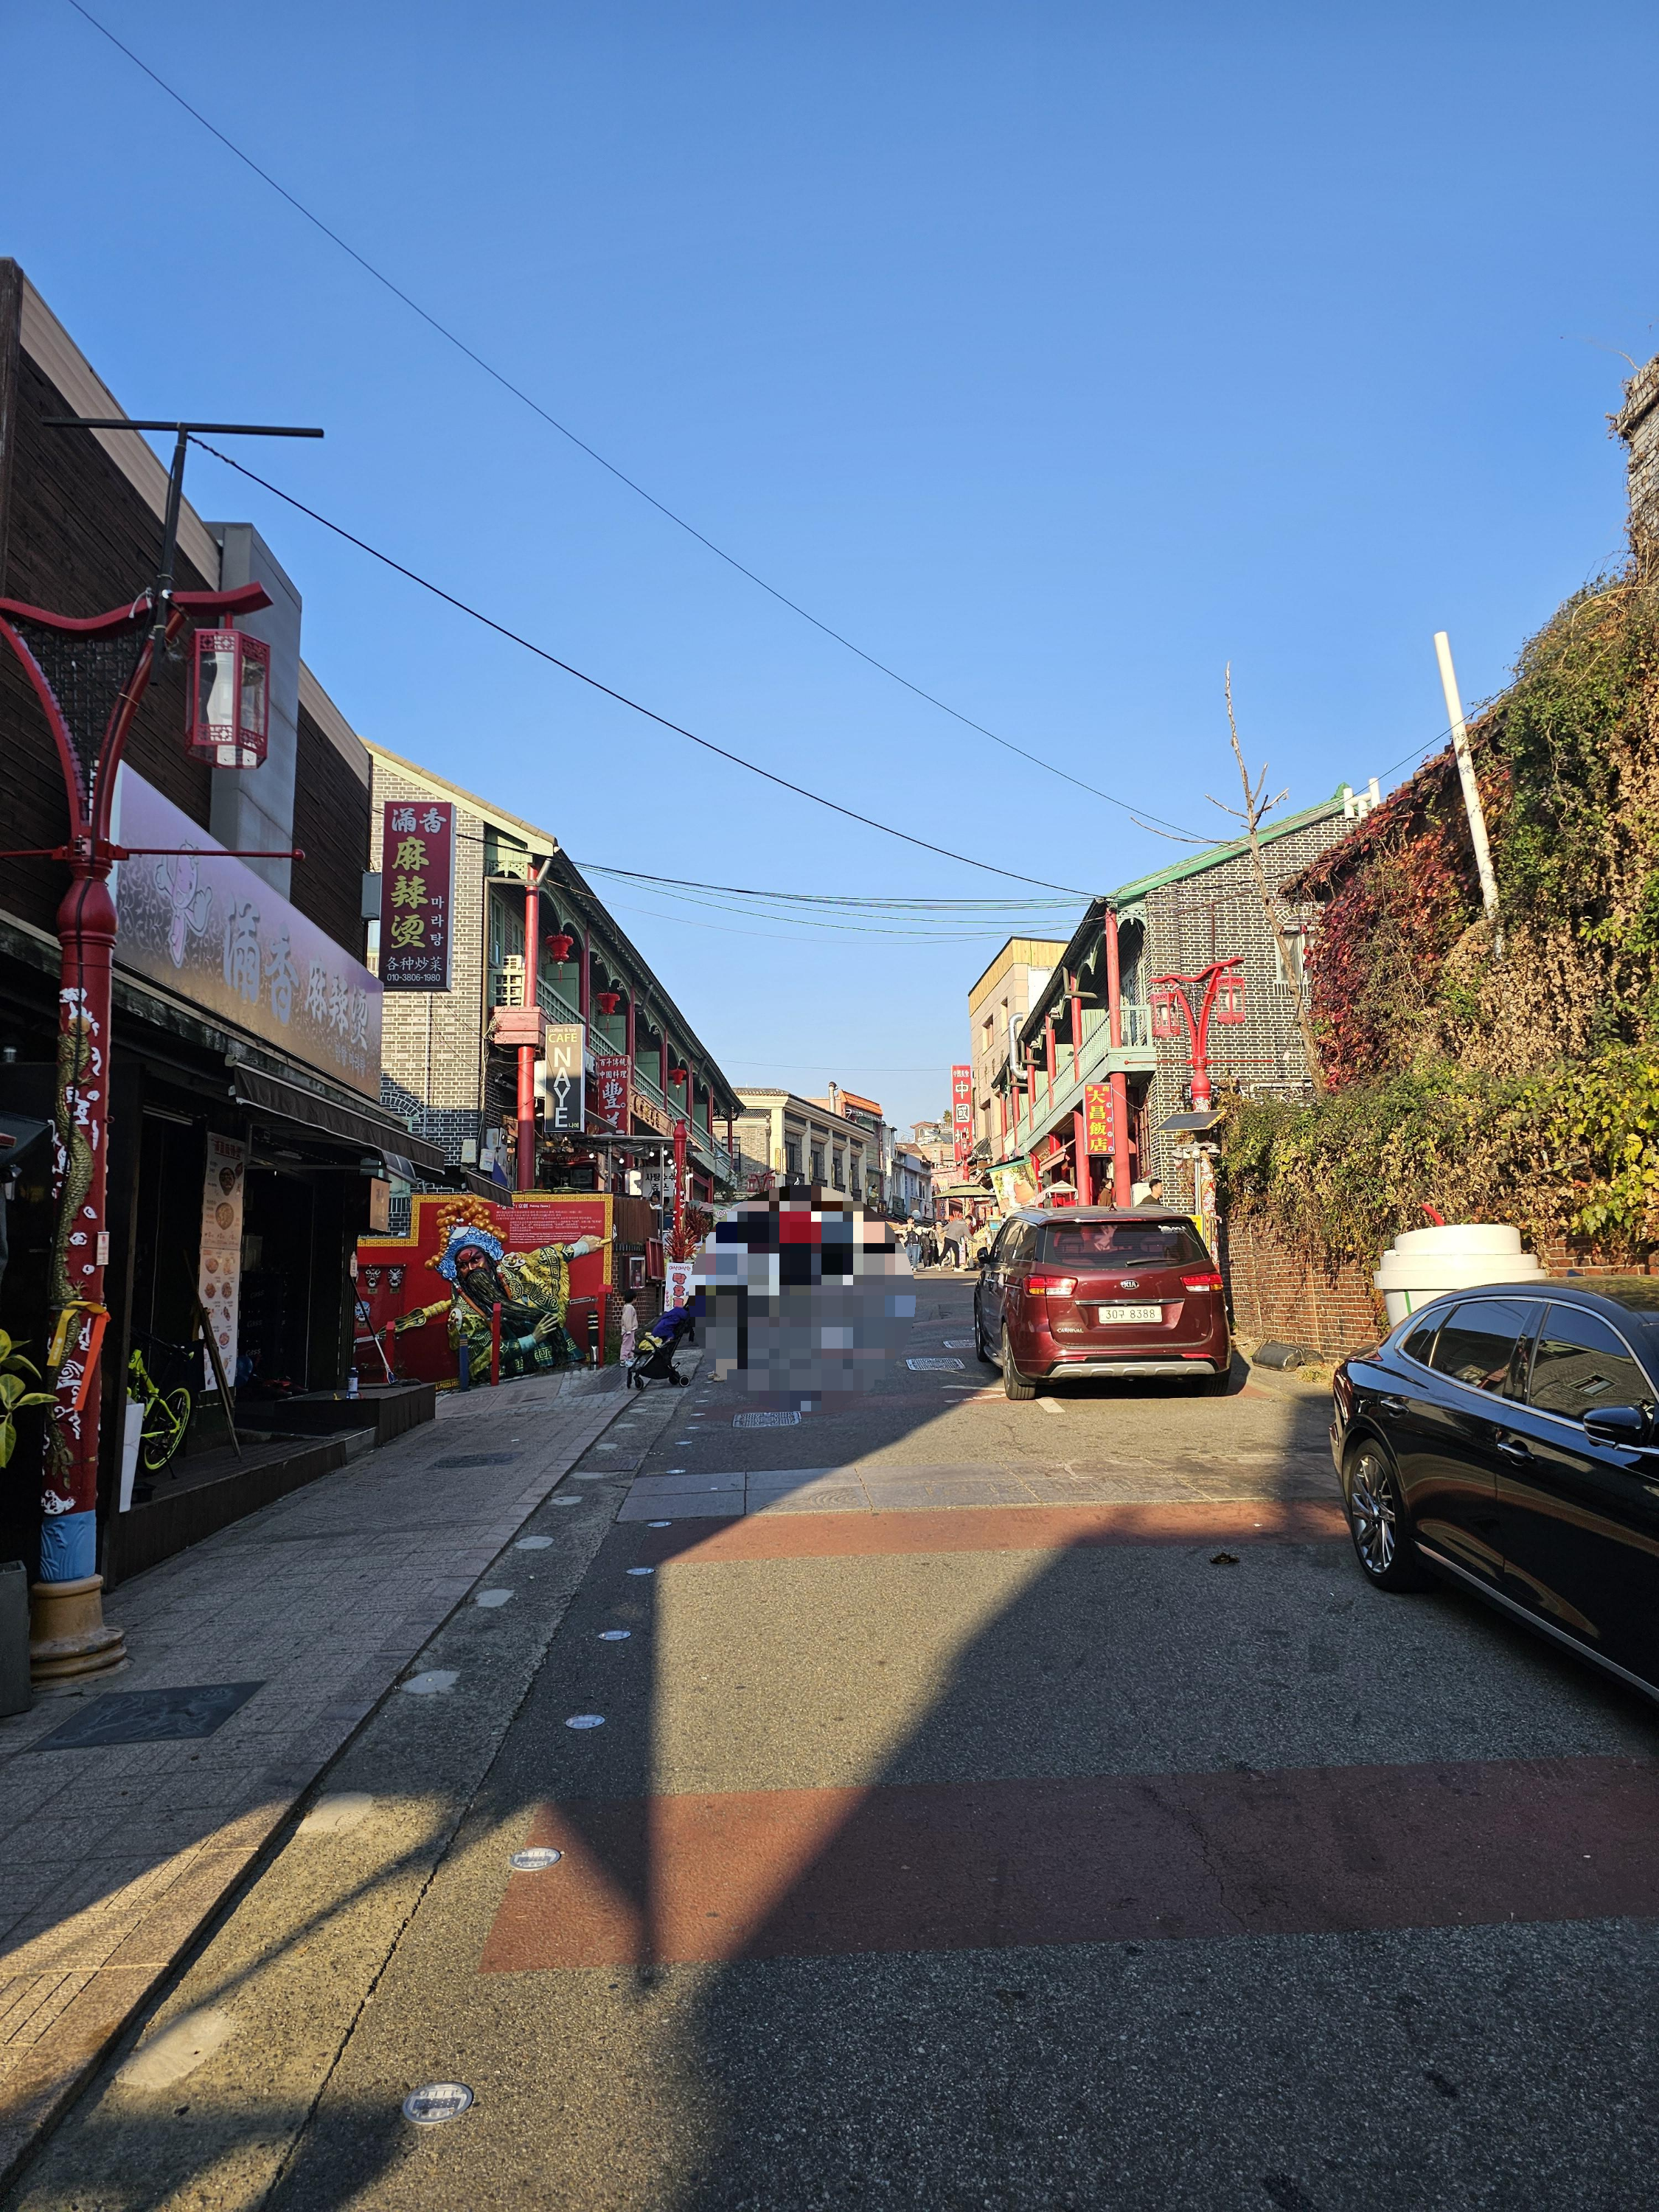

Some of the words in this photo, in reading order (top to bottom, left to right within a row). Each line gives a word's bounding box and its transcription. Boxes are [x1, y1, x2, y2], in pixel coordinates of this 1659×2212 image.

[431, 896, 445, 947] 마라탕
[386, 956, 442, 972] 各种炒菜
[387, 973, 440, 981] 010-3806-1980
[549, 1033, 577, 1043] CAFE
[554, 1046, 571, 1128] NAYE
[1088, 1090, 1107, 1152] 大昌飯店
[1130, 1309, 1155, 1318] 8388
